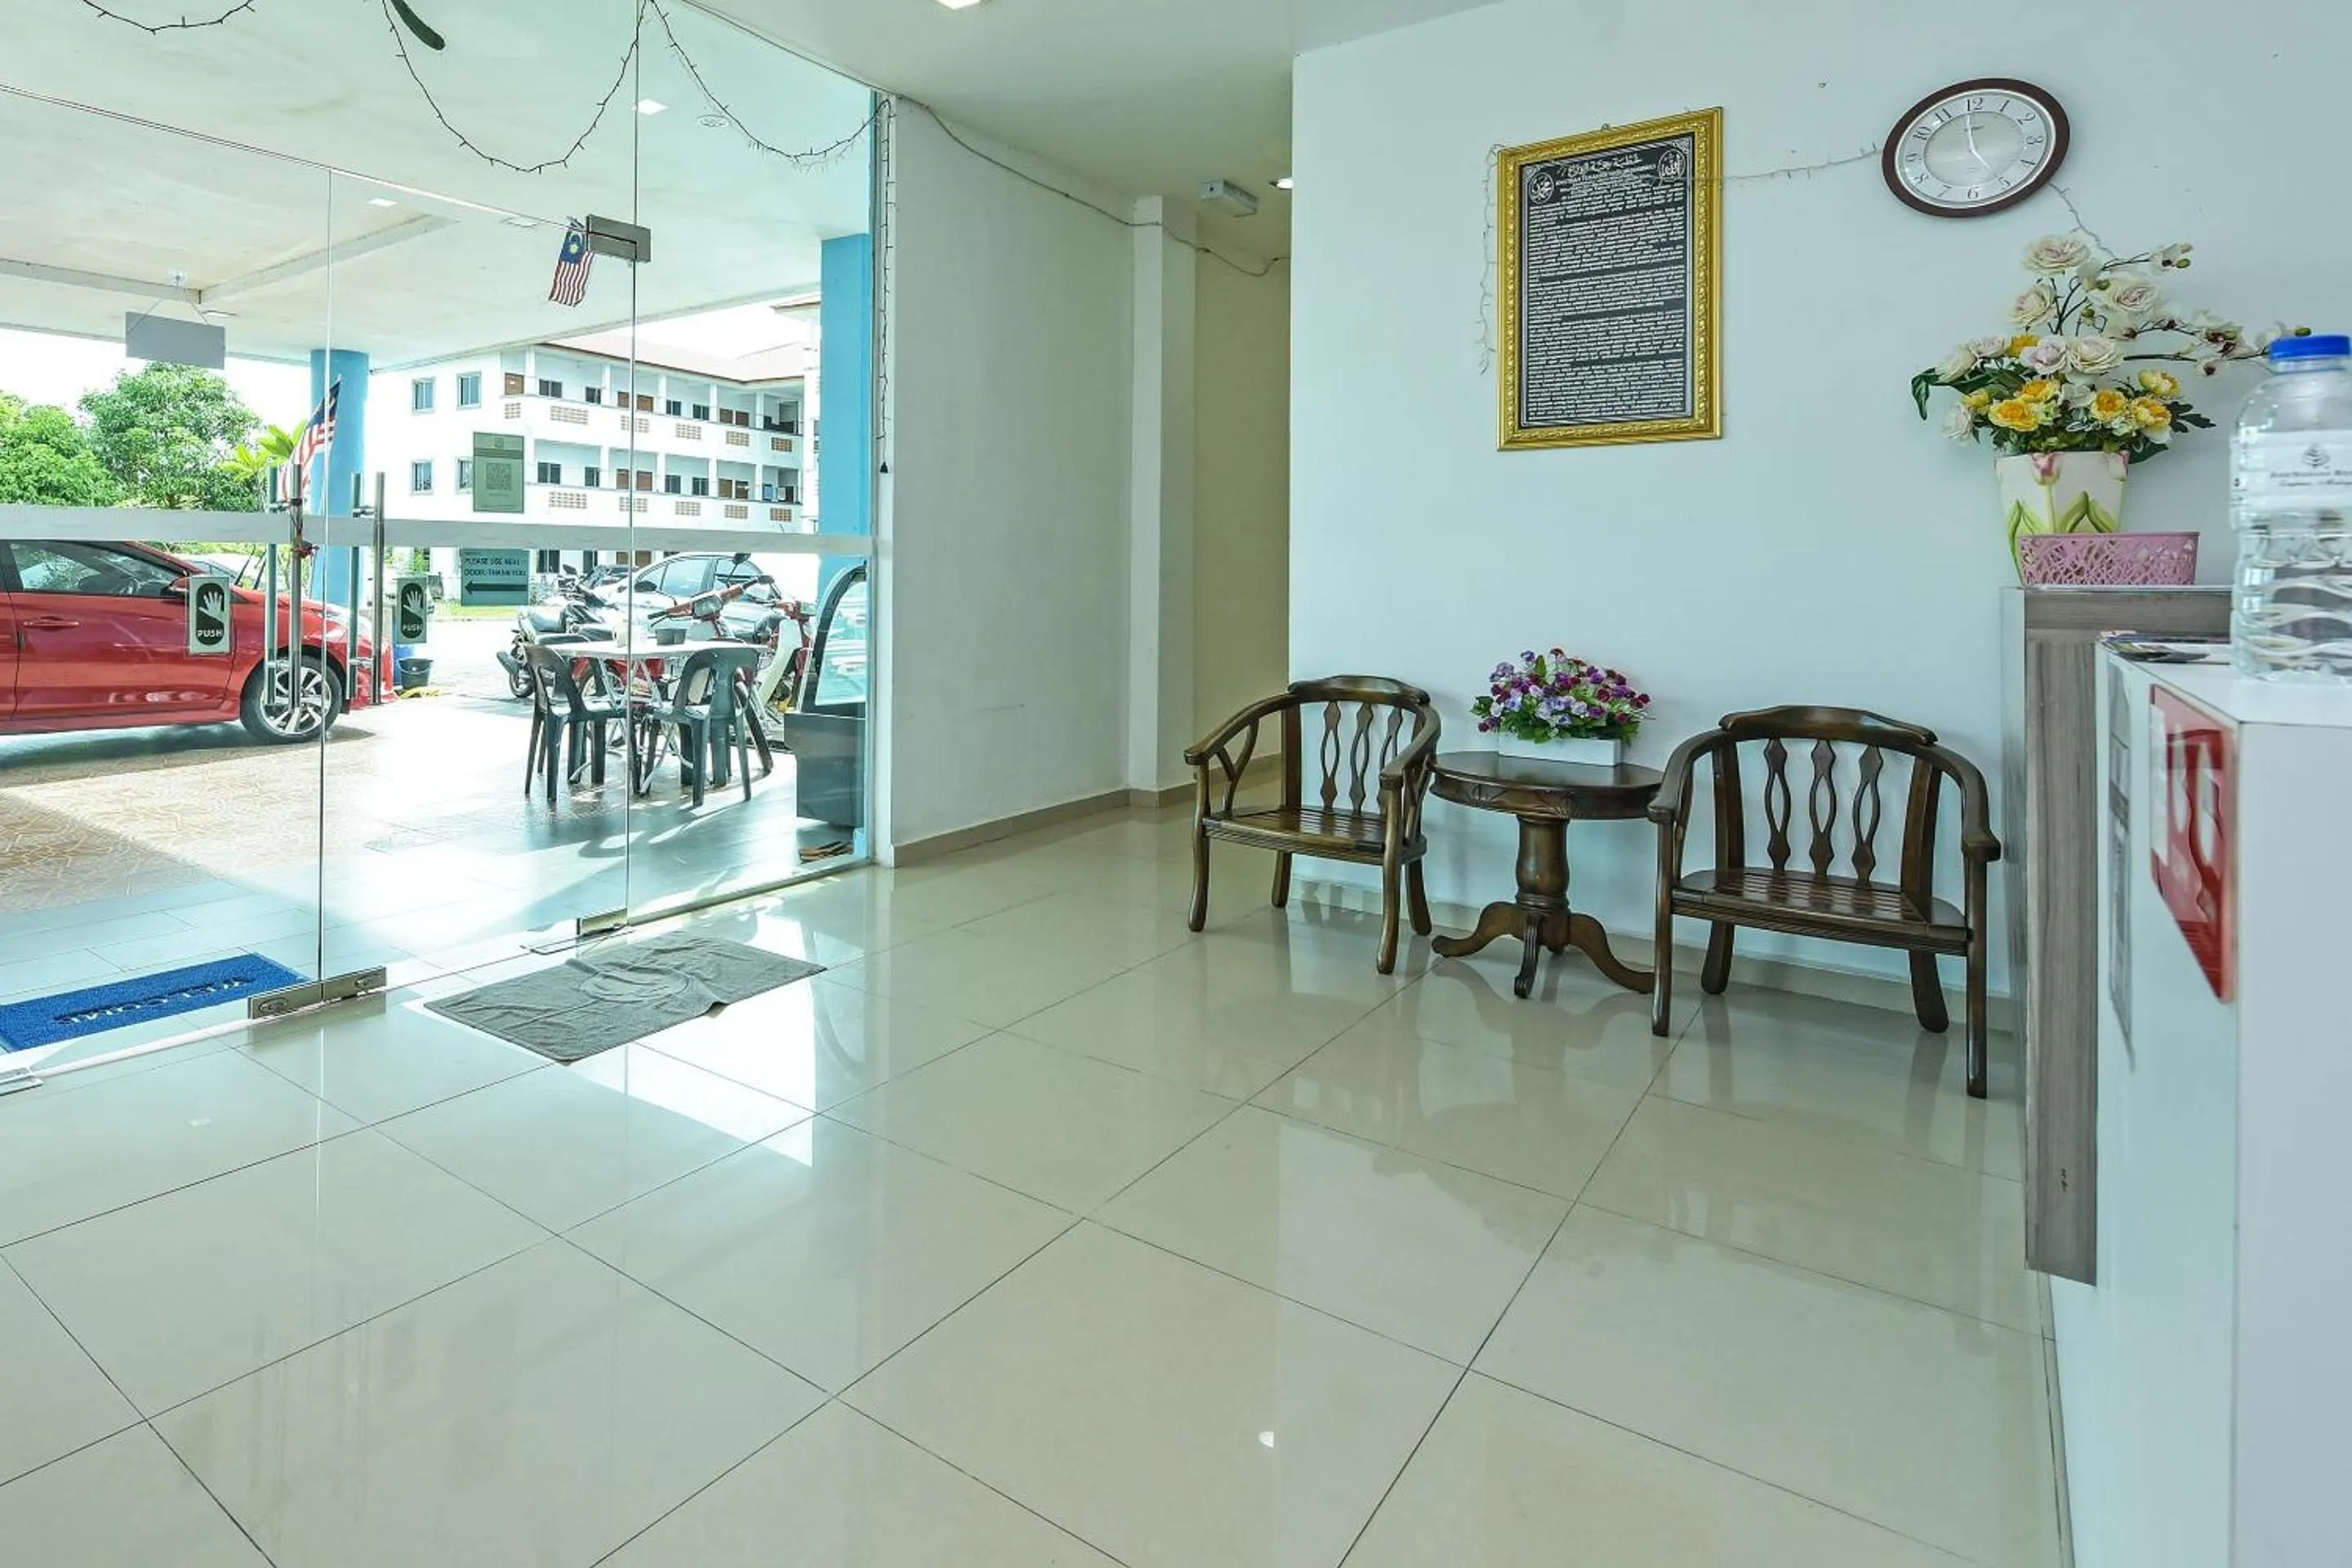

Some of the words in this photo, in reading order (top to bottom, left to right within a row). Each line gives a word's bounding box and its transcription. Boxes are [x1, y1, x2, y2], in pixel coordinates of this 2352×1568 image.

[1966, 96, 1984, 113] 12
[1998, 100, 2010, 113] 1
[1934, 108, 1953, 124] 11
[2017, 112, 2037, 126] 2
[1913, 126, 1933, 141] 10
[2025, 136, 2045, 145] 3
[1967, 186, 1982, 200] 6
[197, 629, 223, 637] PUSH
[402, 623, 422, 631] PUSH
